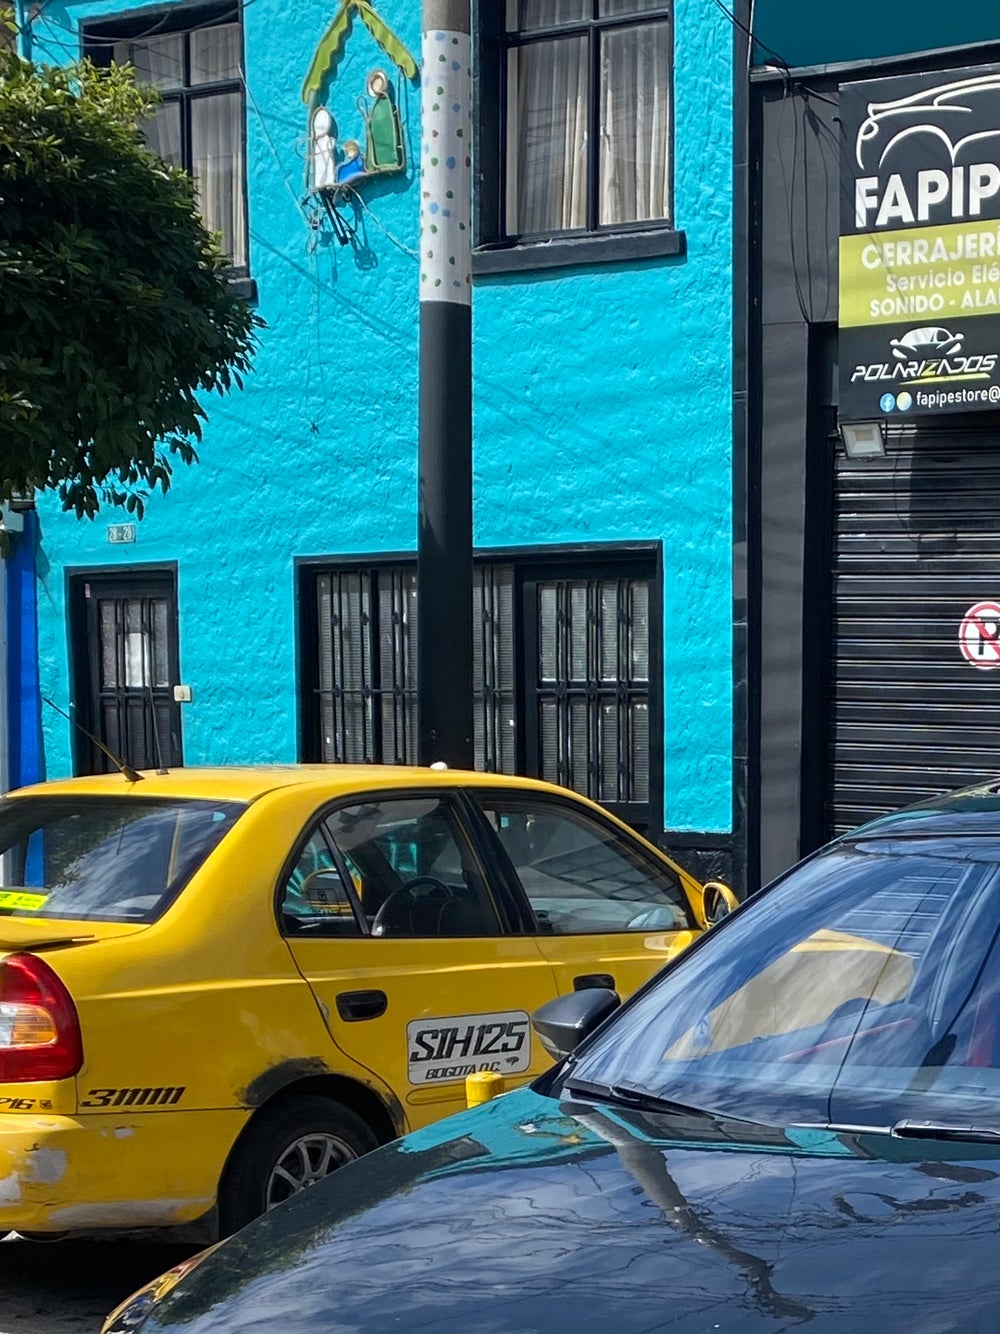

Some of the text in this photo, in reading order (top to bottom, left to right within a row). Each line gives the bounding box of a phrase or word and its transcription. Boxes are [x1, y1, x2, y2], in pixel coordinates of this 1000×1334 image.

[885, 264, 965, 292] Servicio
[870, 295, 944, 318] SONIDO
[851, 354, 998, 383] POLARIZADOS
[425, 1064, 476, 1080] BOGOTA
[80, 1086, 186, 1108] 3111111
